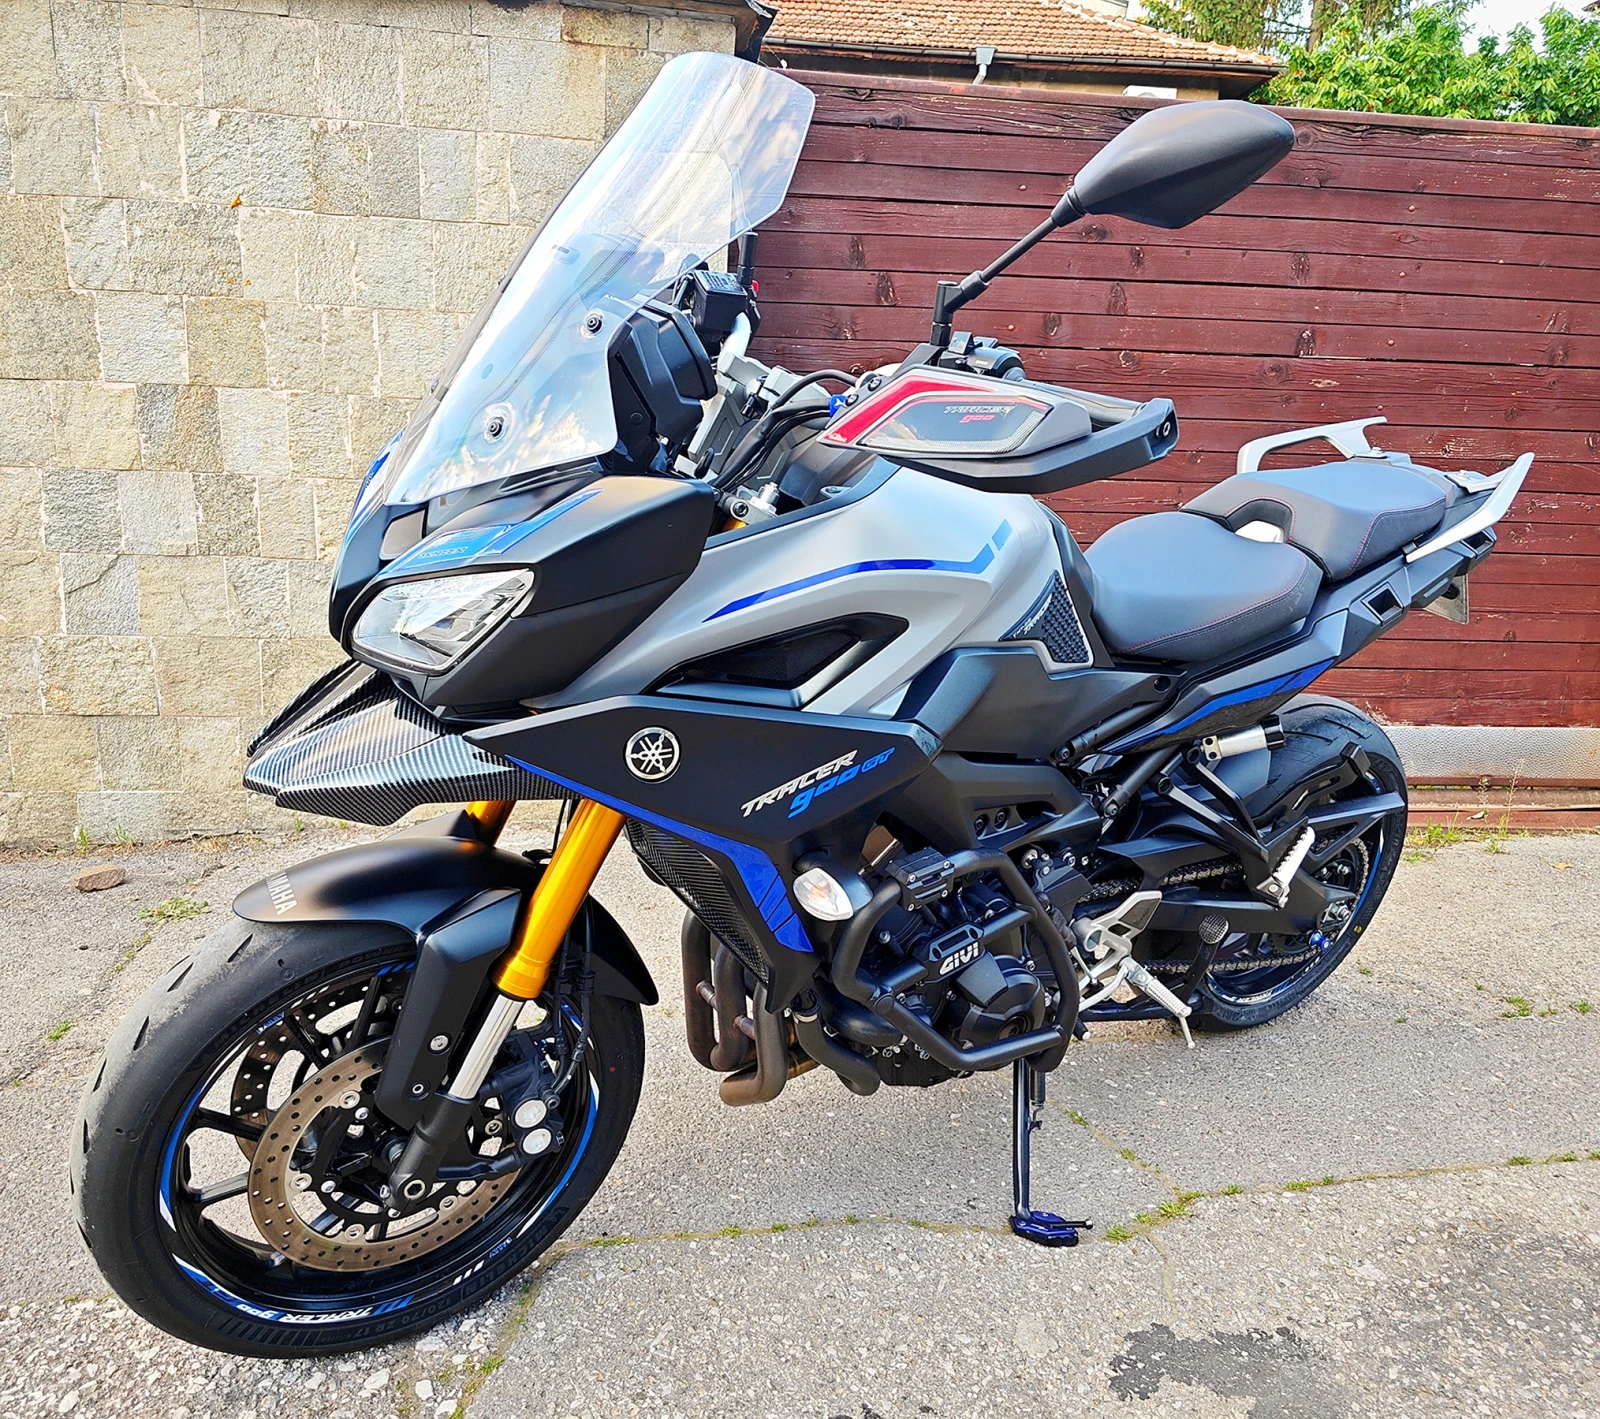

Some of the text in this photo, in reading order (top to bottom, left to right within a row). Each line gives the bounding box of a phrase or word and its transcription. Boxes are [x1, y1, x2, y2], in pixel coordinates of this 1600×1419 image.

[944, 405, 1016, 414] TRACER
[959, 415, 994, 424] 900
[741, 750, 858, 818] TRACER
[788, 764, 860, 819] 900
[266, 871, 298, 915] AMAHA
[939, 942, 979, 976] GIVI
[236, 1303, 374, 1323] TRACER 900
